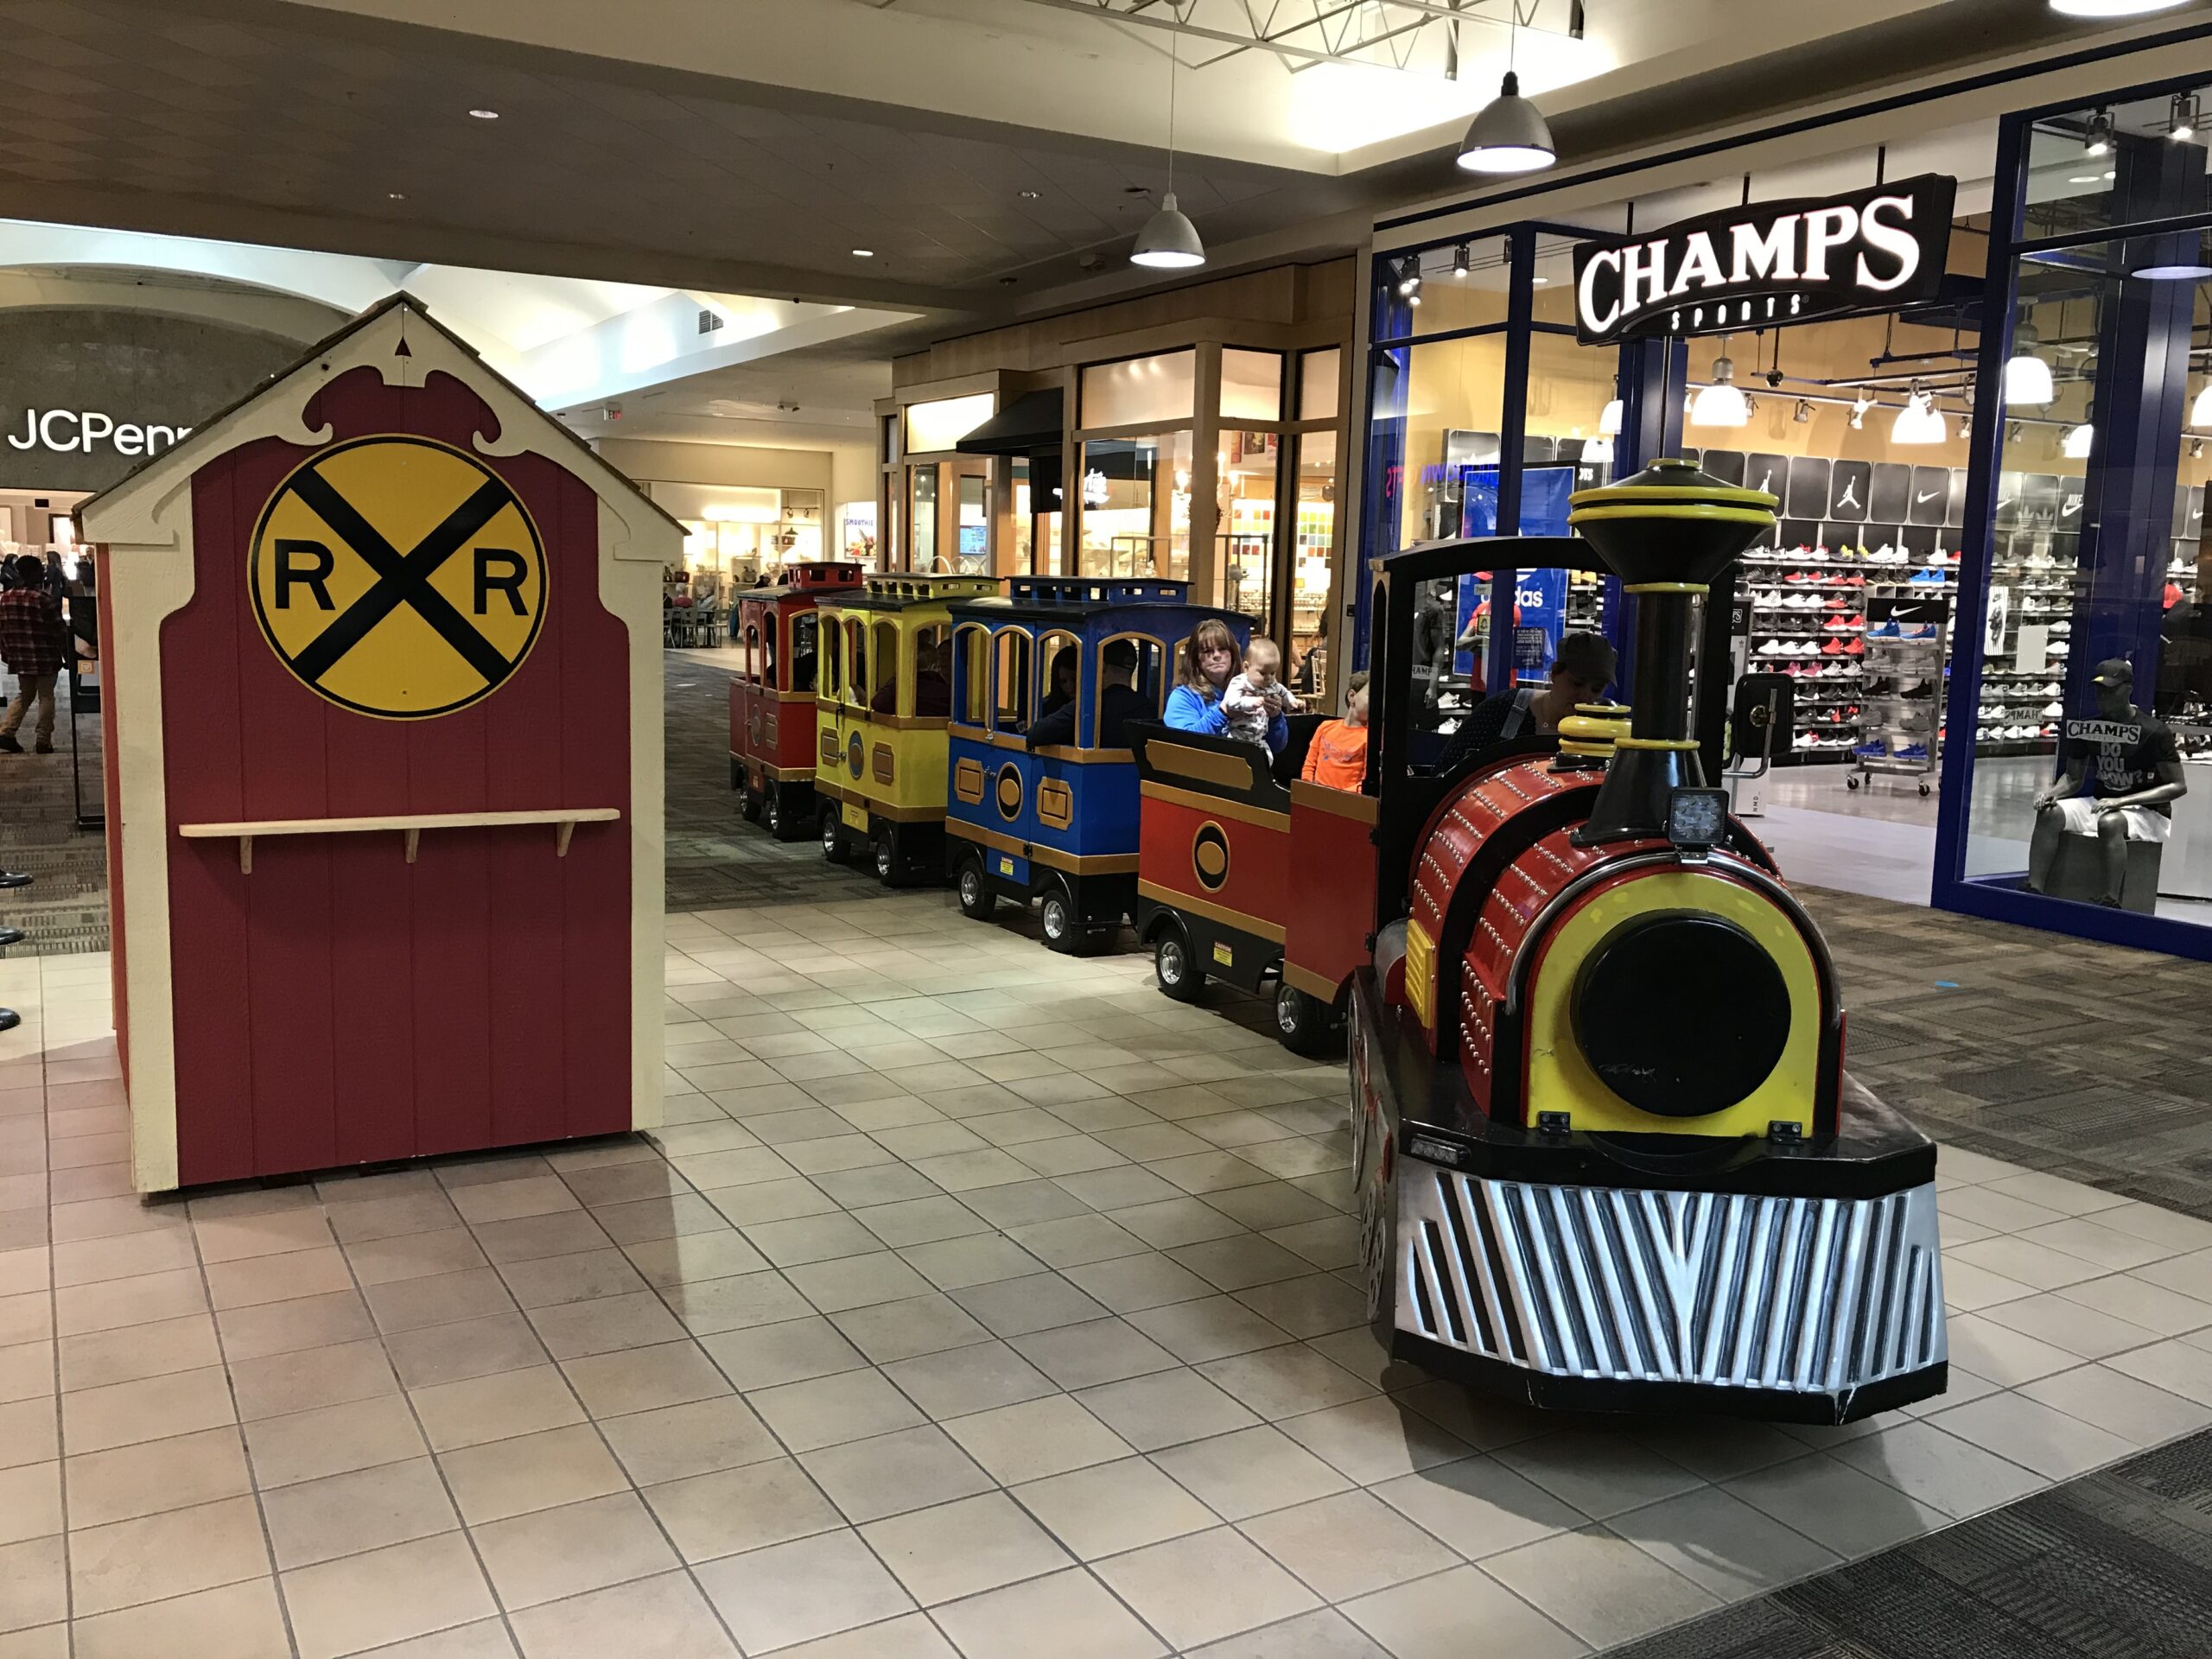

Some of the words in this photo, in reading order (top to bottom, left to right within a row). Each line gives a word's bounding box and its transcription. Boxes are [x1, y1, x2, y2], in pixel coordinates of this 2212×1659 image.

[1579, 194, 1920, 334] CHAMPS
[1671, 294, 1801, 331] SPORTS
[274, 538, 336, 611] R
[474, 547, 530, 616] R
[2067, 721, 2139, 742] CHAMPS
[2096, 755, 2125, 772] YOU
[2101, 742, 2121, 757] DO
